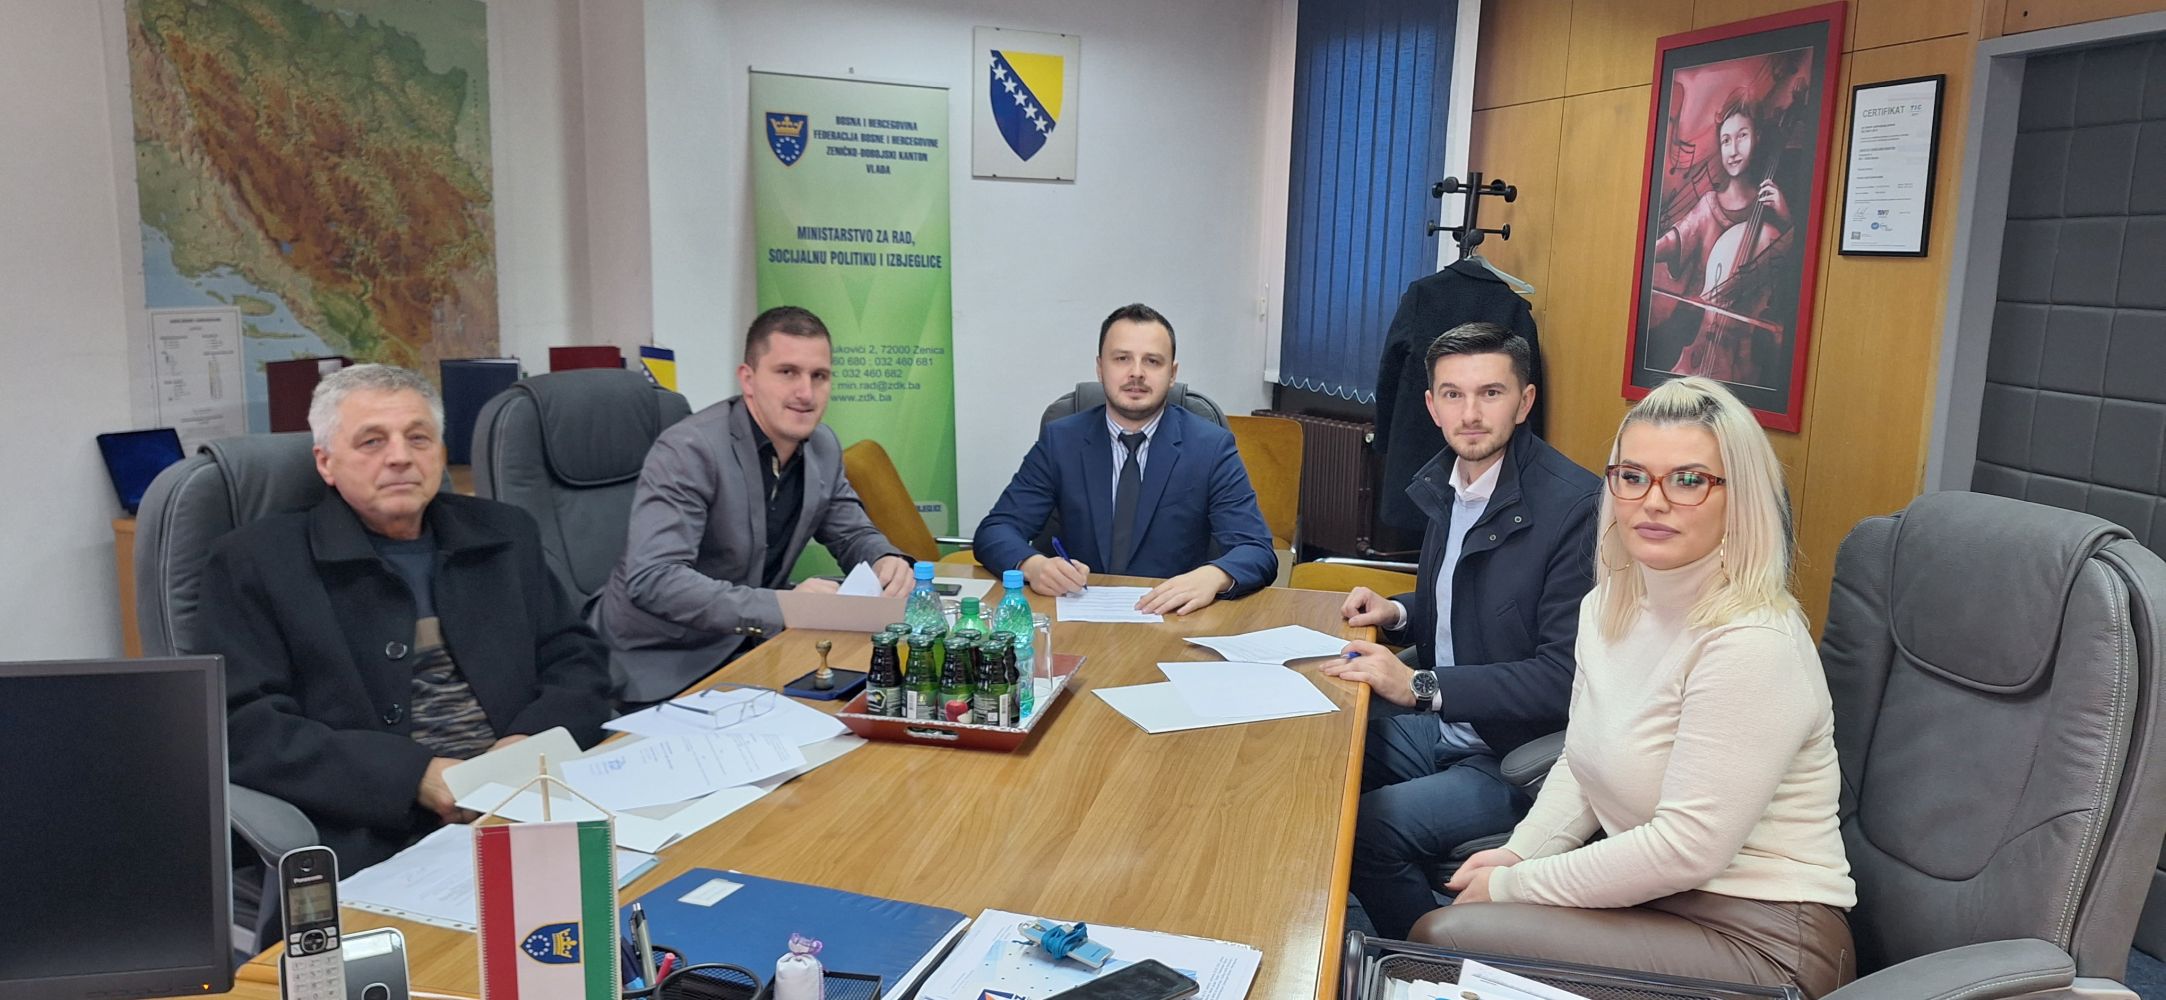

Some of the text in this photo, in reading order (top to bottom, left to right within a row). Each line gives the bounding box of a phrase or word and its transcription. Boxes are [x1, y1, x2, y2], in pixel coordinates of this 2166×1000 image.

[1862, 105, 1906, 118] CERTIFIKAT
[835, 115, 861, 127] BOSNA
[868, 118, 918, 131] HERCEGOVINA
[813, 130, 858, 142] FEDERACIJA
[861, 133, 884, 144] BOSNE
[892, 136, 939, 148] HERCEGOVINE
[899, 151, 928, 162] KANTON
[866, 164, 891, 174] VLADA
[797, 226, 915, 247] MINISTARSTVO ZA RAD,
[768, 248, 827, 265] SOCIJALNU
[830, 251, 876, 266] POLITIKU
[886, 254, 942, 268] IZBJEGLICE
[881, 345, 911, 354] 72000
[913, 345, 945, 355] Zenica
[832, 357, 845, 366] 60
[874, 357, 893, 366] 032
[915, 358, 933, 366] 681
[842, 369, 861, 378] 032
[884, 369, 903, 378] 682
